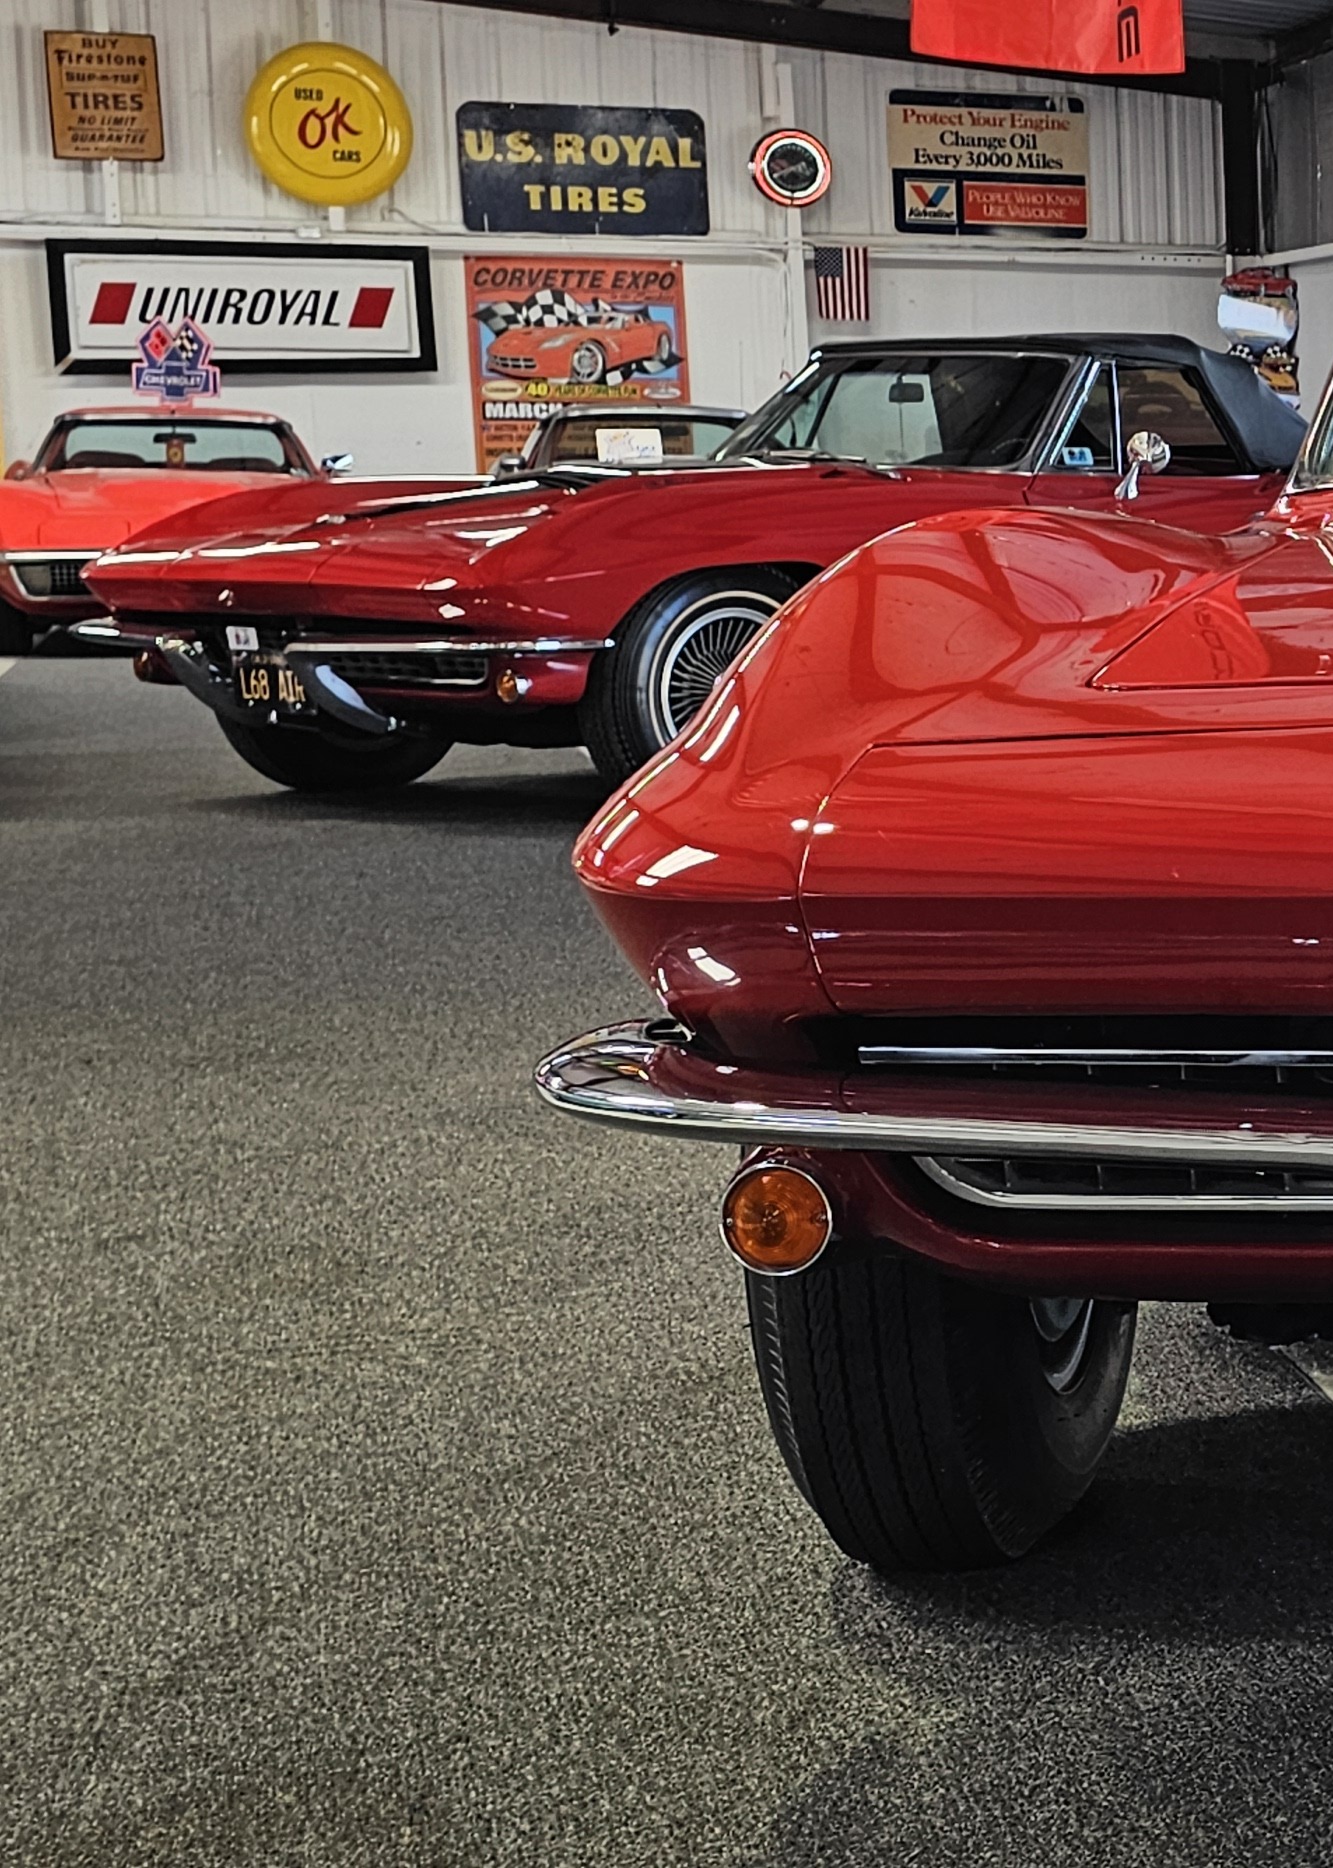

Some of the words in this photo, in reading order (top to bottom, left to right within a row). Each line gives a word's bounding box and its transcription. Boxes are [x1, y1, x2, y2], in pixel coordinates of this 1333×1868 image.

[81, 37, 119, 49] BUY
[54, 48, 148, 67] Firestone
[64, 92, 144, 111] TIRES
[294, 87, 323, 101] USED
[77, 115, 98, 125] NO
[100, 115, 138, 127] LIMIT
[298, 97, 363, 150] OK
[902, 108, 964, 126] Protect
[967, 110, 1007, 128] Your
[1010, 113, 1070, 132] Engine
[71, 133, 147, 144] GUARANTEE
[463, 128, 543, 163] U.S.
[554, 132, 702, 168] ROYAL
[939, 130, 1007, 150] Change
[1010, 132, 1037, 150] Oil
[332, 149, 361, 163] CARS
[914, 148, 962, 168] Every
[966, 151, 1013, 169] 3,000
[1016, 153, 1063, 169] Miles
[523, 184, 646, 213] TIRES
[969, 190, 1012, 204] PEOPLE
[1014, 191, 1043, 205] WHO
[1045, 192, 1080, 206] KNOW
[908, 206, 955, 219] Valvoline
[982, 204, 1006, 216] USE
[1007, 205, 1066, 219] VALVOLINE
[473, 267, 607, 289] CORVETTE
[610, 270, 677, 290] EXPO
[138, 287, 341, 326] UNIROYAL
[240, 667, 270, 700] L68
